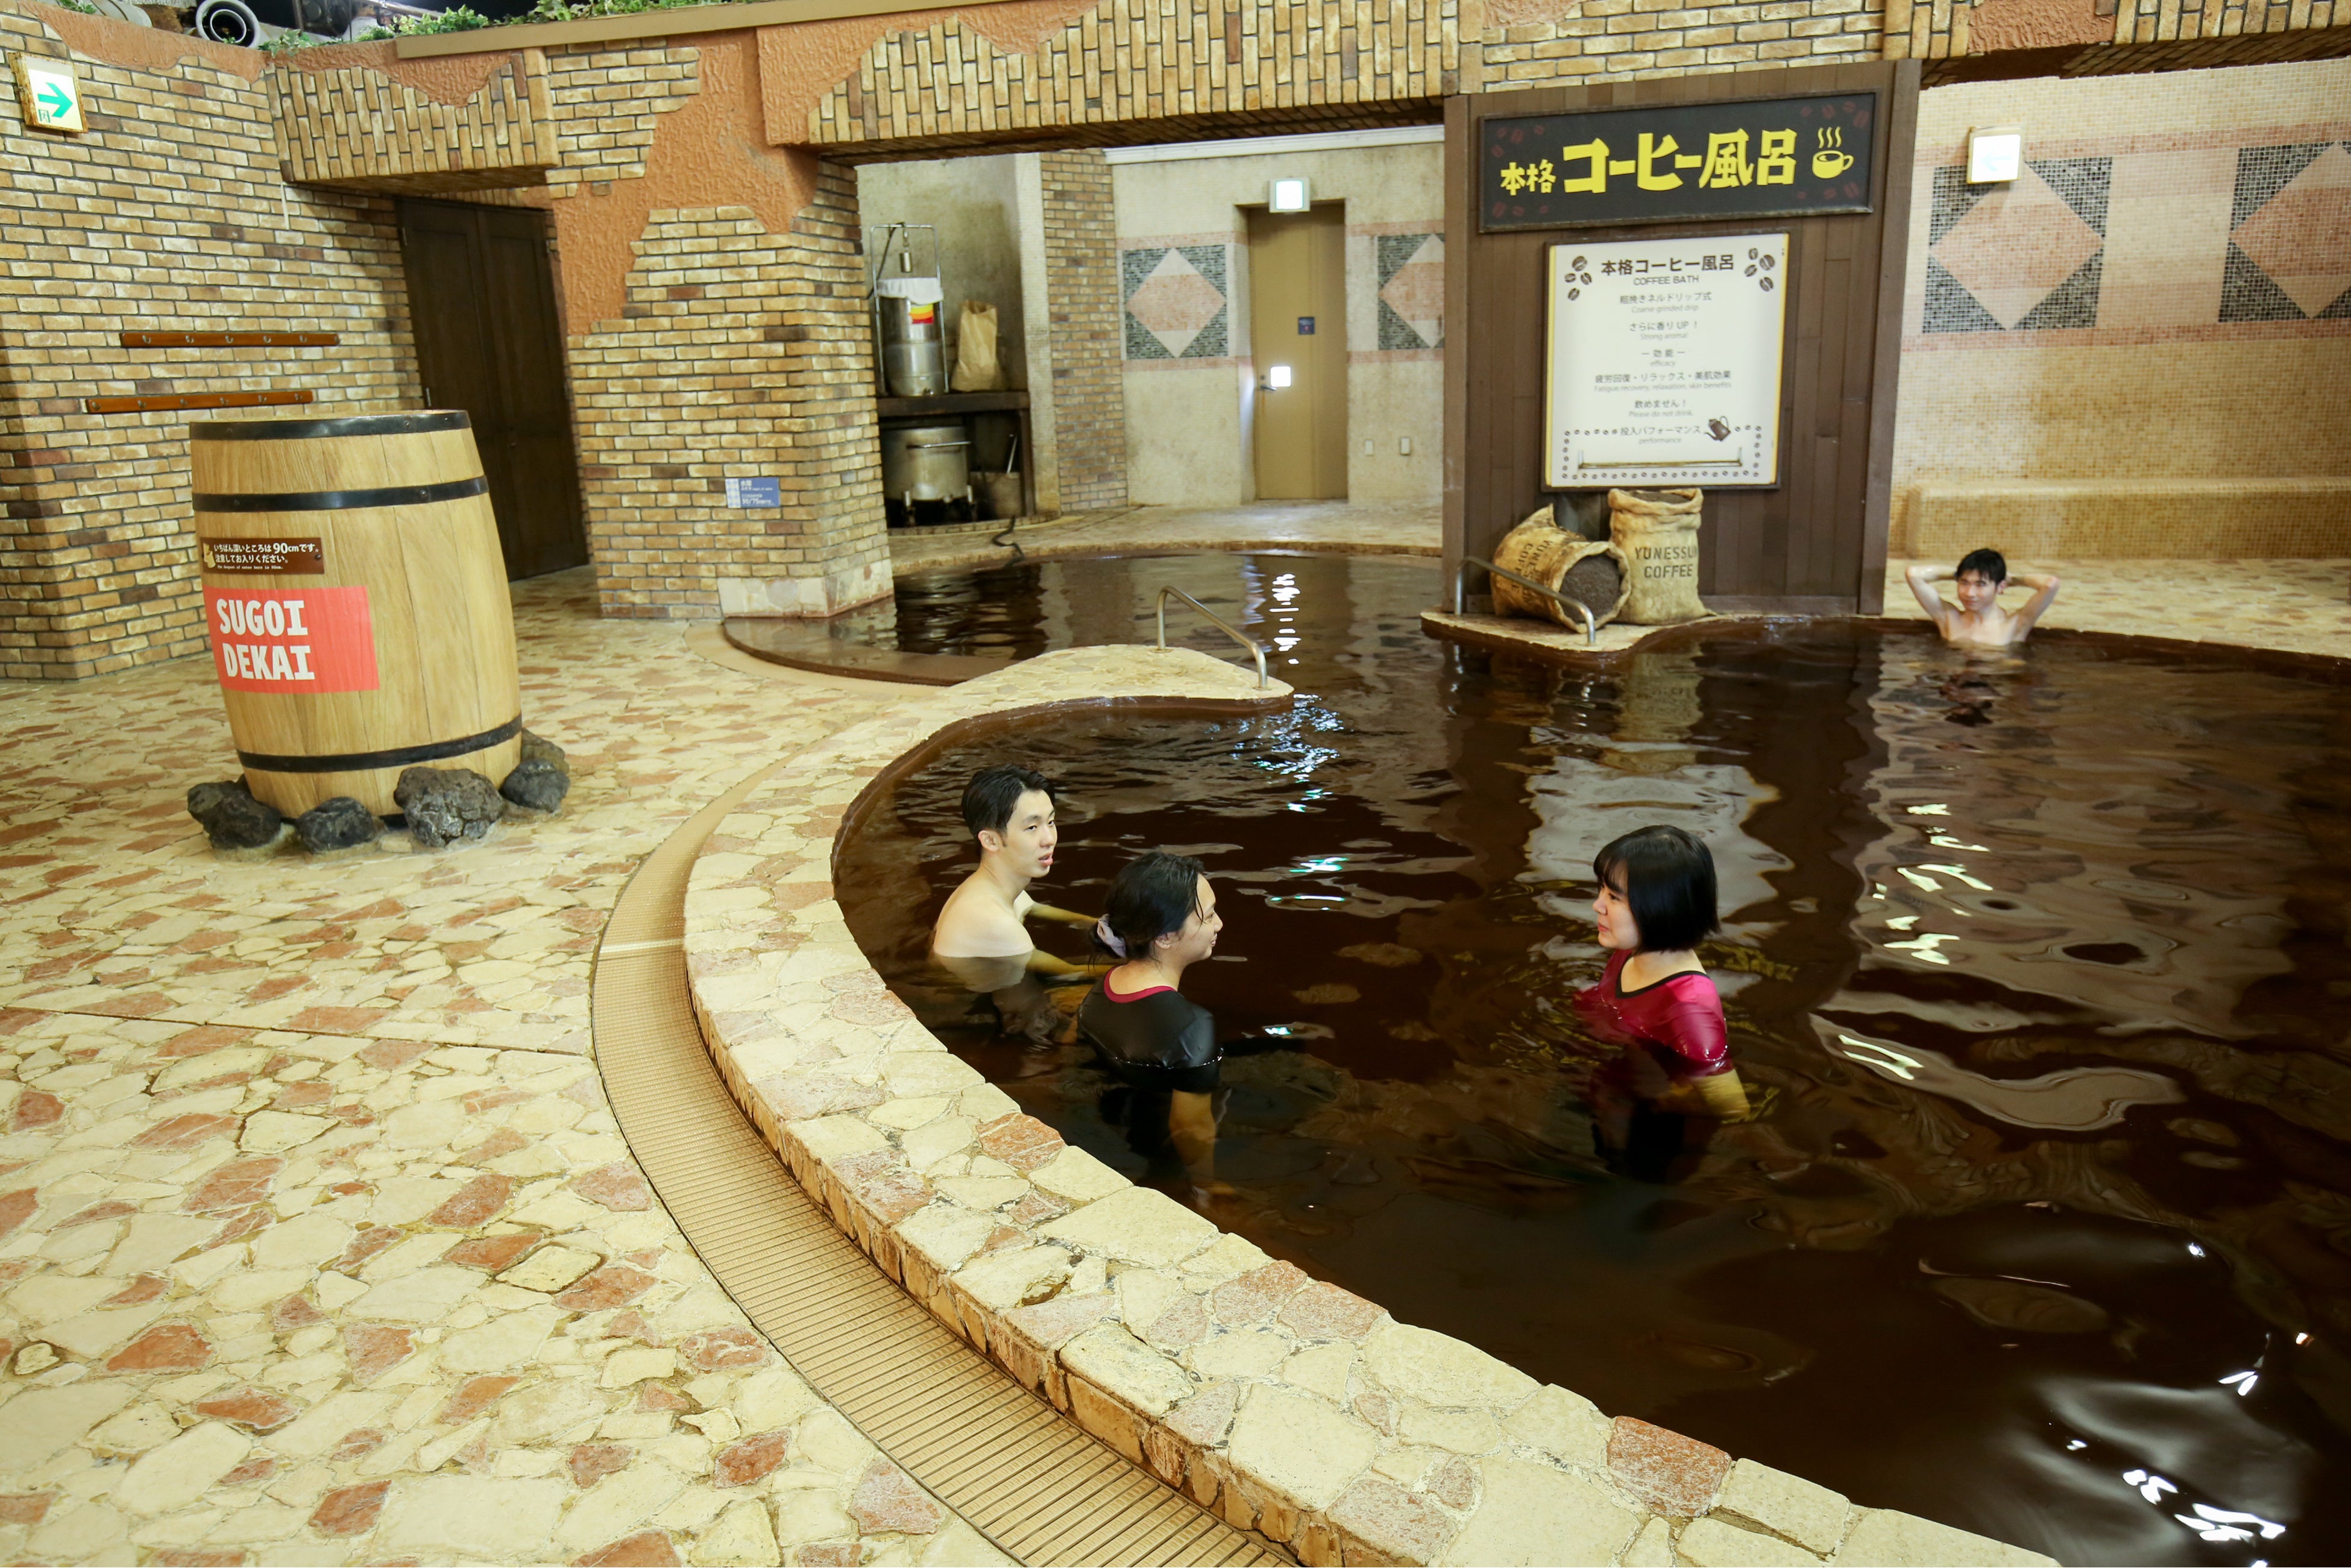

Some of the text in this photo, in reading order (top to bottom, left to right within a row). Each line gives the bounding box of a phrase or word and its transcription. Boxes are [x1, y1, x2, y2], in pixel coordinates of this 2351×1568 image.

[1500, 128, 1798, 196] 本格コーヒー風呂
[1601, 254, 1734, 276] 本格コーヒー風呂
[1634, 276, 1699, 286] COFFEE BATH
[1644, 564, 1693, 578] COFFEE
[216, 598, 309, 637] SUGOI
[222, 643, 315, 681] DEKAI
